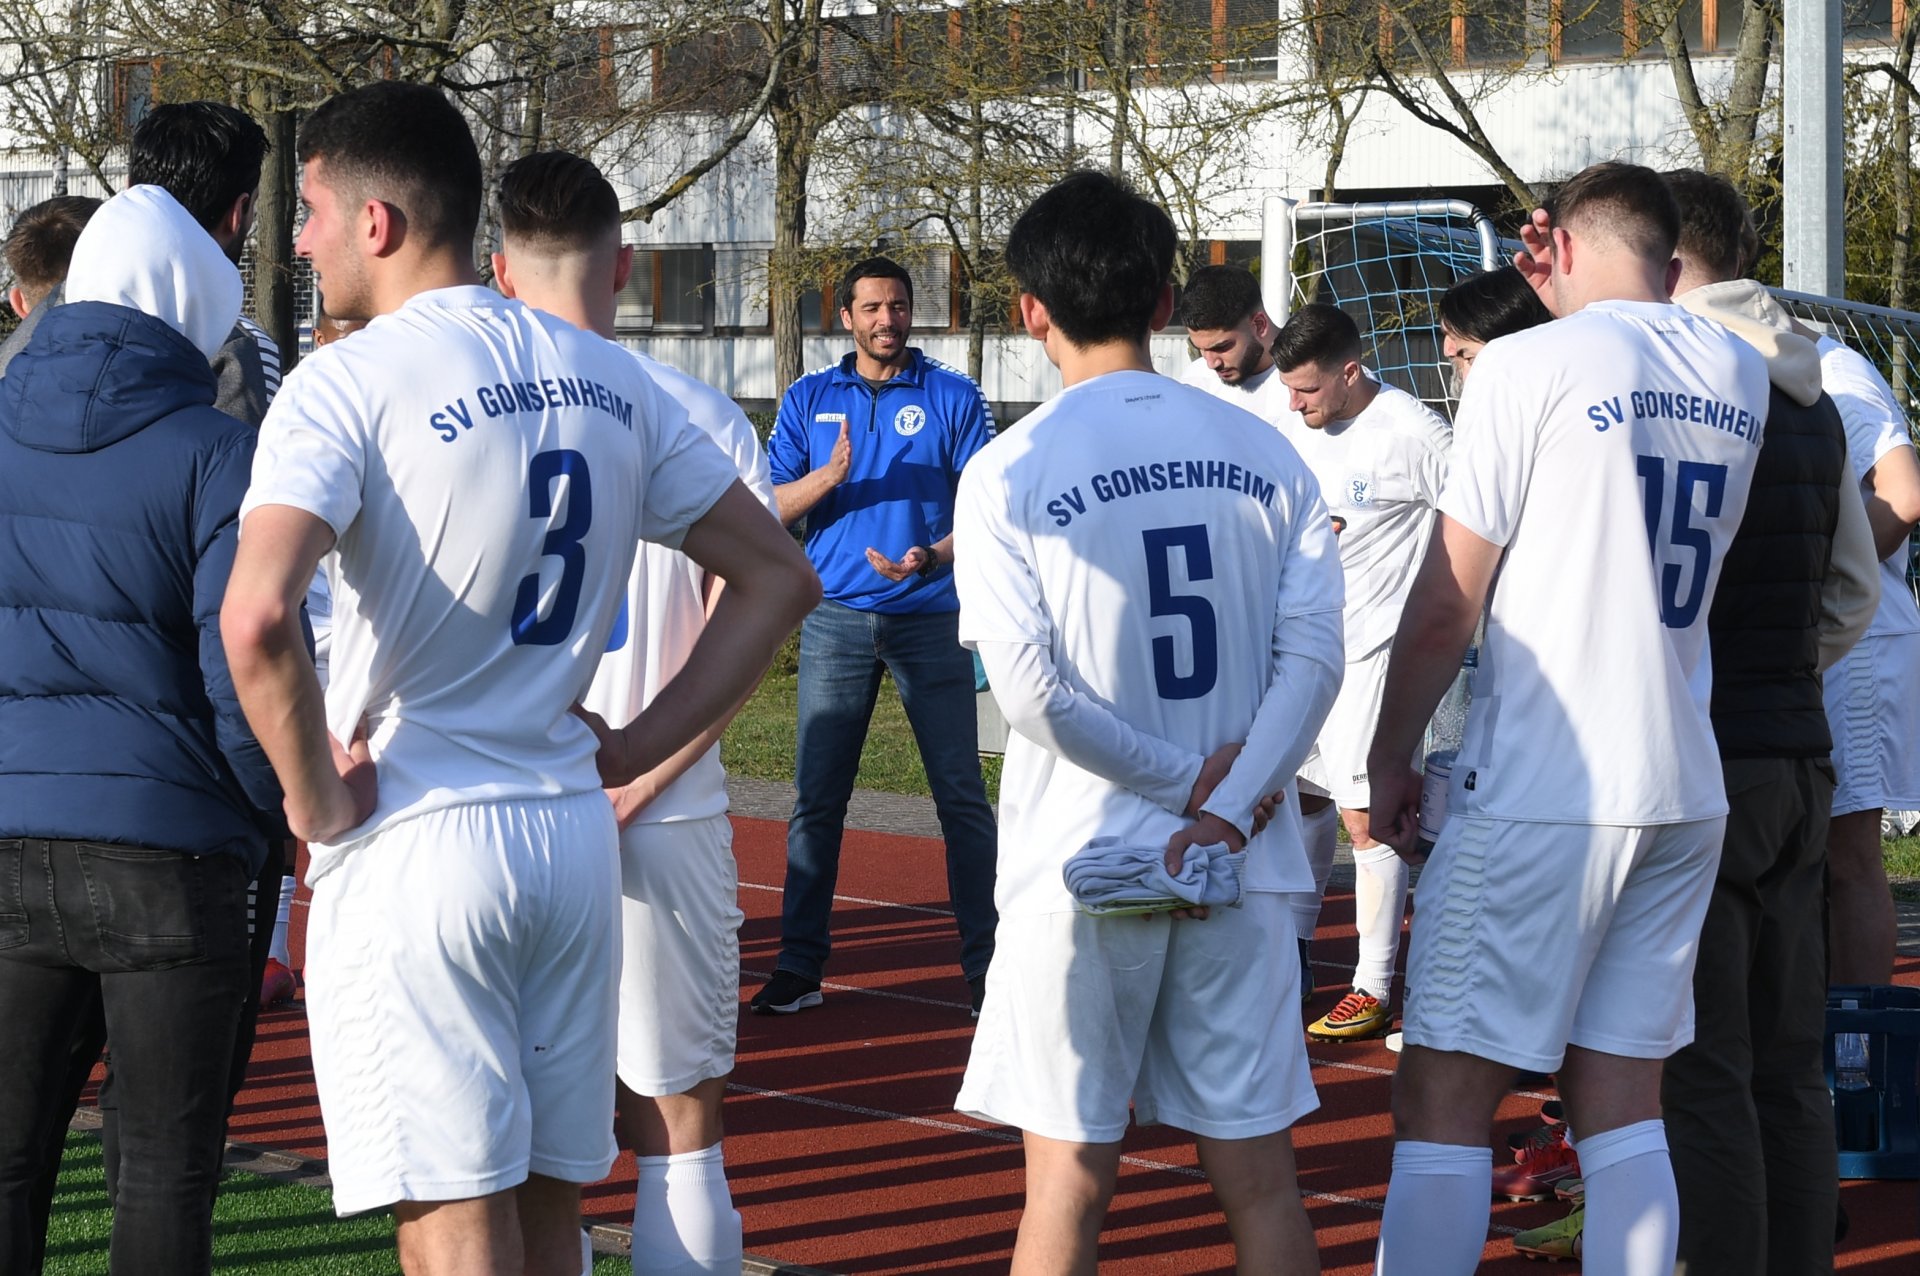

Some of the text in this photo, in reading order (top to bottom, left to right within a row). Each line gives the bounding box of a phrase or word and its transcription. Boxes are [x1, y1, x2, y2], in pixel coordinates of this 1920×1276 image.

[430, 378, 633, 443] SV GONSENHEIM
[903, 411, 919, 422] SV
[1587, 396, 1624, 432] SV
[1047, 460, 1275, 527] SV GONSENHEIM
[1352, 480, 1368, 492] SV
[1354, 491, 1364, 502] G
[510, 449, 592, 645] 3
[1637, 454, 1728, 629] 15
[1142, 524, 1218, 701] 5
